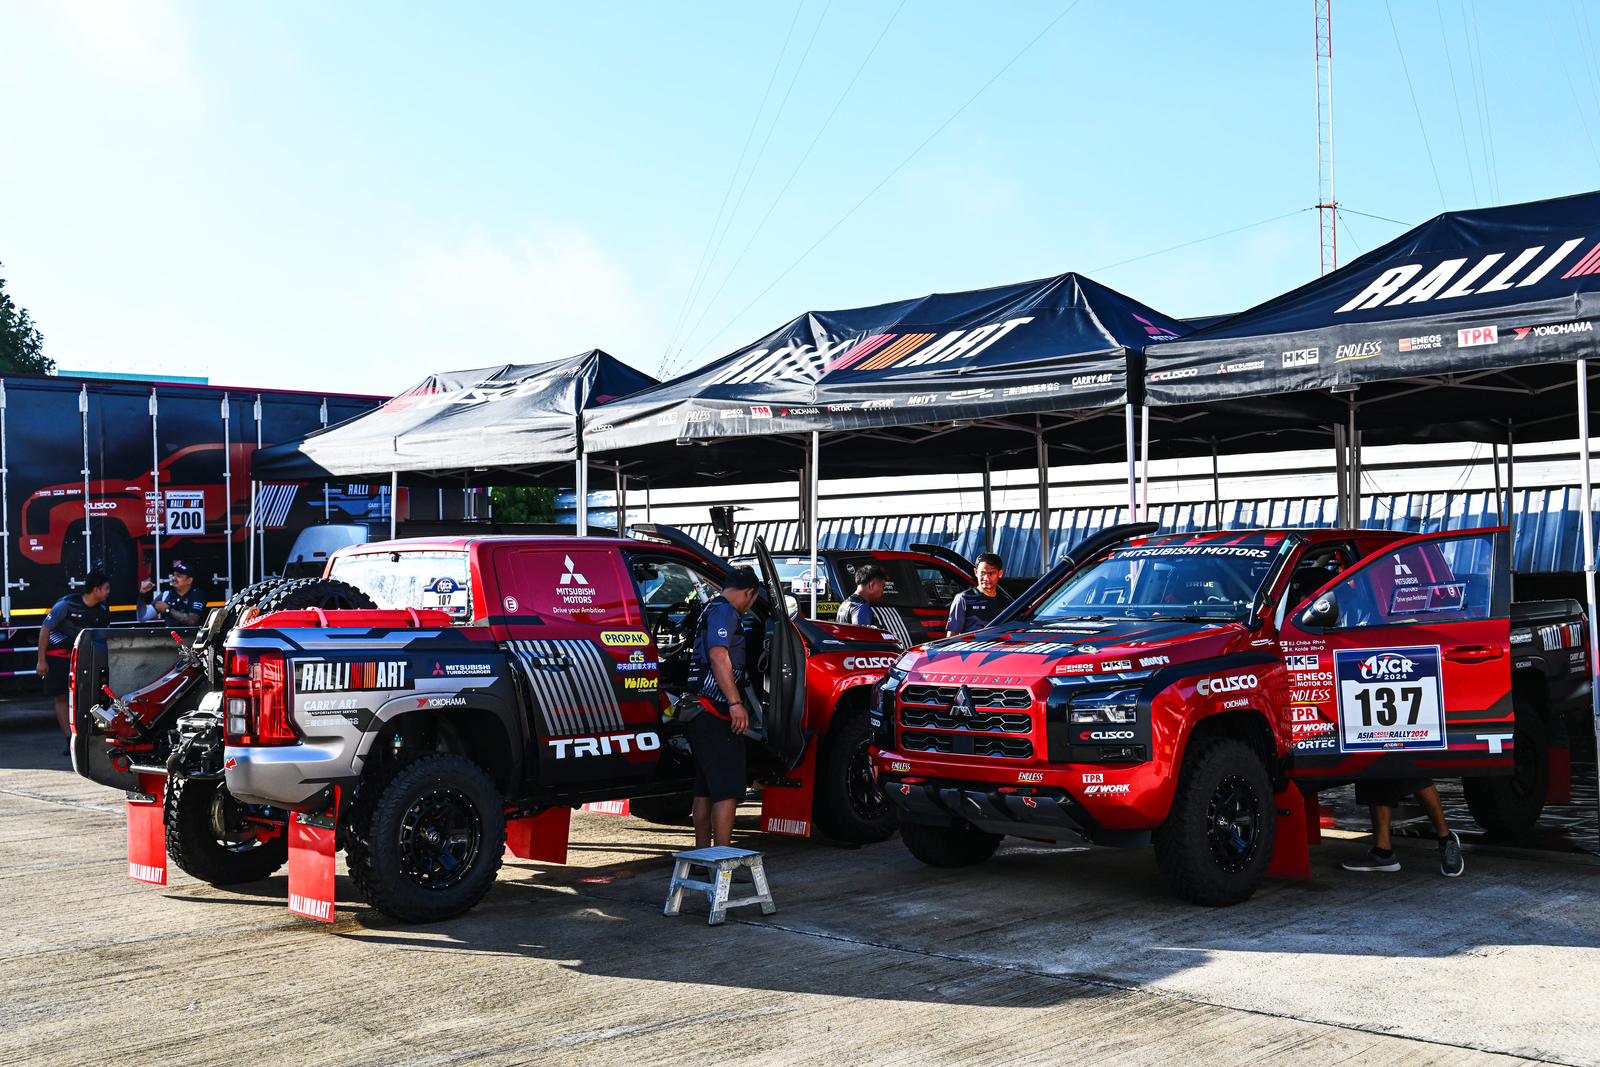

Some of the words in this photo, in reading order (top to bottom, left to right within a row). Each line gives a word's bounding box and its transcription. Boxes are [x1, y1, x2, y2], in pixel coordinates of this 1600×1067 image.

[1534, 321, 1593, 336] YOKOHAMA
[1411, 334, 1442, 344] ENEOS
[1460, 328, 1495, 345] TPR
[1336, 341, 1382, 359] ENDLESS
[1283, 349, 1318, 364] HKS
[1227, 360, 1264, 369] MITSUBISHI
[1160, 368, 1198, 380] CUSCO
[1072, 376, 1096, 386] CARRY
[1096, 374, 1112, 382] ART
[870, 398, 895, 407] WORK
[908, 394, 938, 405] Moty's
[751, 406, 771, 418] TPR
[788, 407, 820, 415] YOKOHAMA
[658, 414, 677, 424] HKS
[171, 511, 202, 530] 200
[1118, 546, 1202, 558] MITSUBISHI
[1201, 547, 1270, 558] MOTORS
[556, 588, 596, 596] MITSUBISHI
[438, 594, 452, 606] 107
[605, 634, 646, 643] PROPAK
[1102, 660, 1131, 668] HKS
[1138, 655, 1170, 668] Moty's
[920, 674, 1022, 684] MITSUBISHI
[1296, 672, 1333, 680] ENEOS
[1210, 674, 1258, 693] CUSCO
[304, 700, 338, 711] CARRY
[338, 698, 358, 710] ART
[428, 697, 466, 707] YOKOHAMA
[1223, 698, 1249, 709] YOKOHAMA
[1354, 686, 1422, 726] 137
[1303, 722, 1335, 732] WORK
[1090, 730, 1134, 740] CUSCO
[548, 732, 660, 759] TRITO
[1476, 734, 1514, 754] T
[892, 762, 911, 770] ENDLESS
[1018, 772, 1044, 781] ENDLESS
[1084, 774, 1102, 783] TPR
[1100, 784, 1131, 792] WORK
